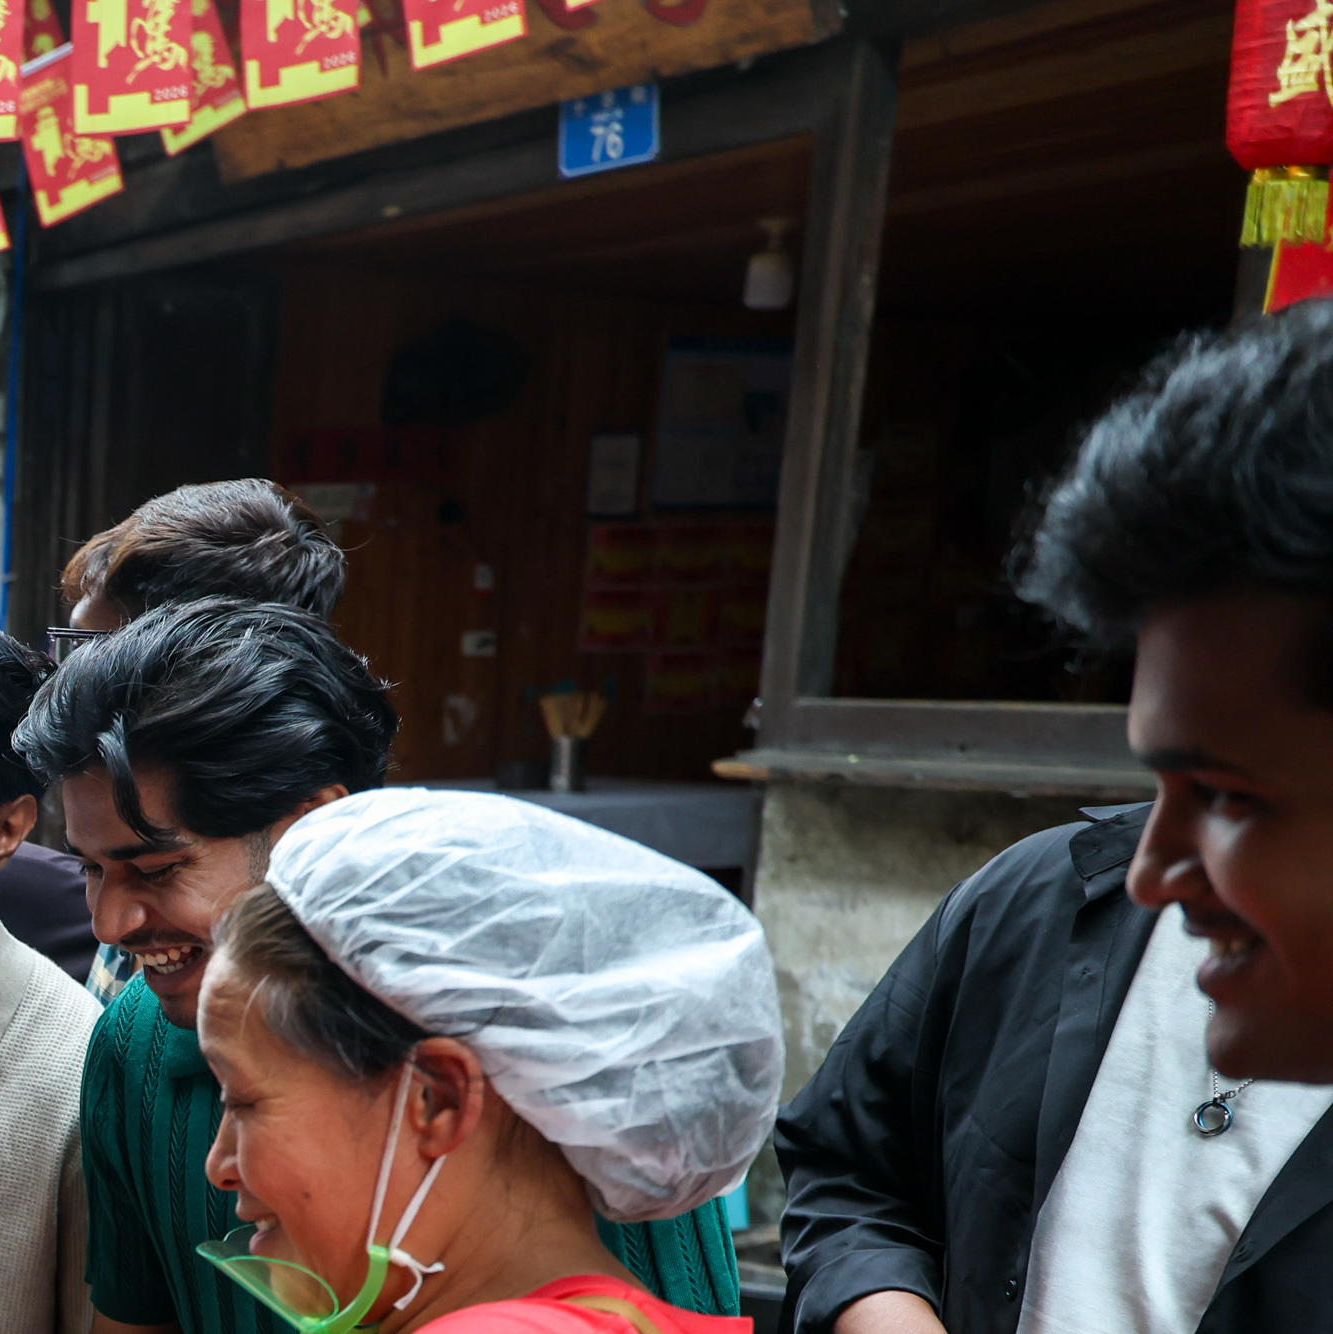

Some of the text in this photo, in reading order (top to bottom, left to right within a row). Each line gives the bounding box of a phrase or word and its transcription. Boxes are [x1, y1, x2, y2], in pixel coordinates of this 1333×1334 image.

[323, 51, 357, 69] 2026
[153, 85, 189, 101] 2026
[589, 122, 624, 163] 76
